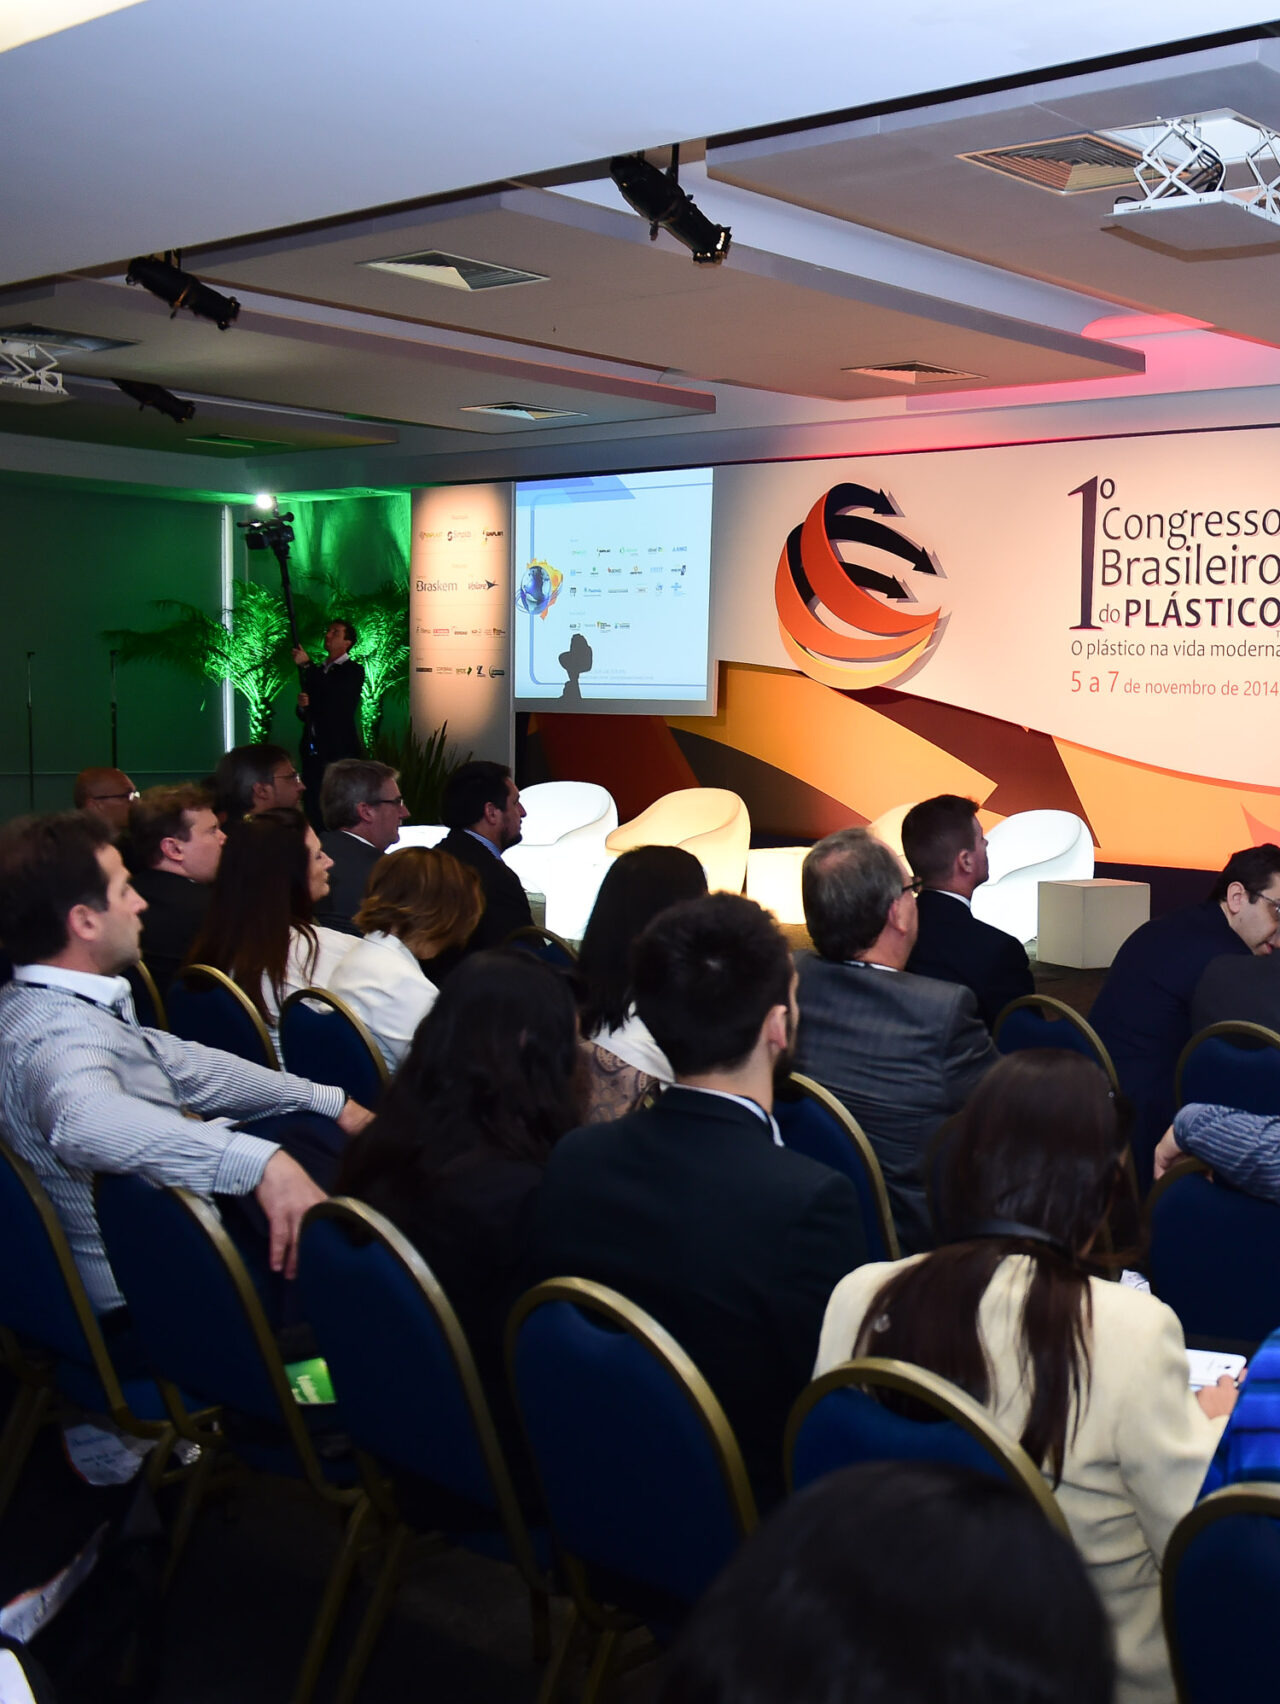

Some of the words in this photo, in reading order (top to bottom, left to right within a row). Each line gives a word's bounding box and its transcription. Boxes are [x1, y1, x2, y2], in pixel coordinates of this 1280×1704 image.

[416, 580, 458, 592] Braskem
[1098, 603, 1121, 623] do
[1071, 640, 1083, 656] O
[1087, 639, 1146, 660] plástico
[1150, 643, 1168, 657] na
[1173, 639, 1206, 657] vida
[1071, 670, 1082, 692] 5
[1089, 676, 1100, 692] a
[1107, 670, 1119, 692] 7
[1124, 678, 1141, 693] de
[1145, 679, 1217, 696] novembro
[1220, 680, 1240, 696] de
[1243, 680, 1280, 697] 2014
